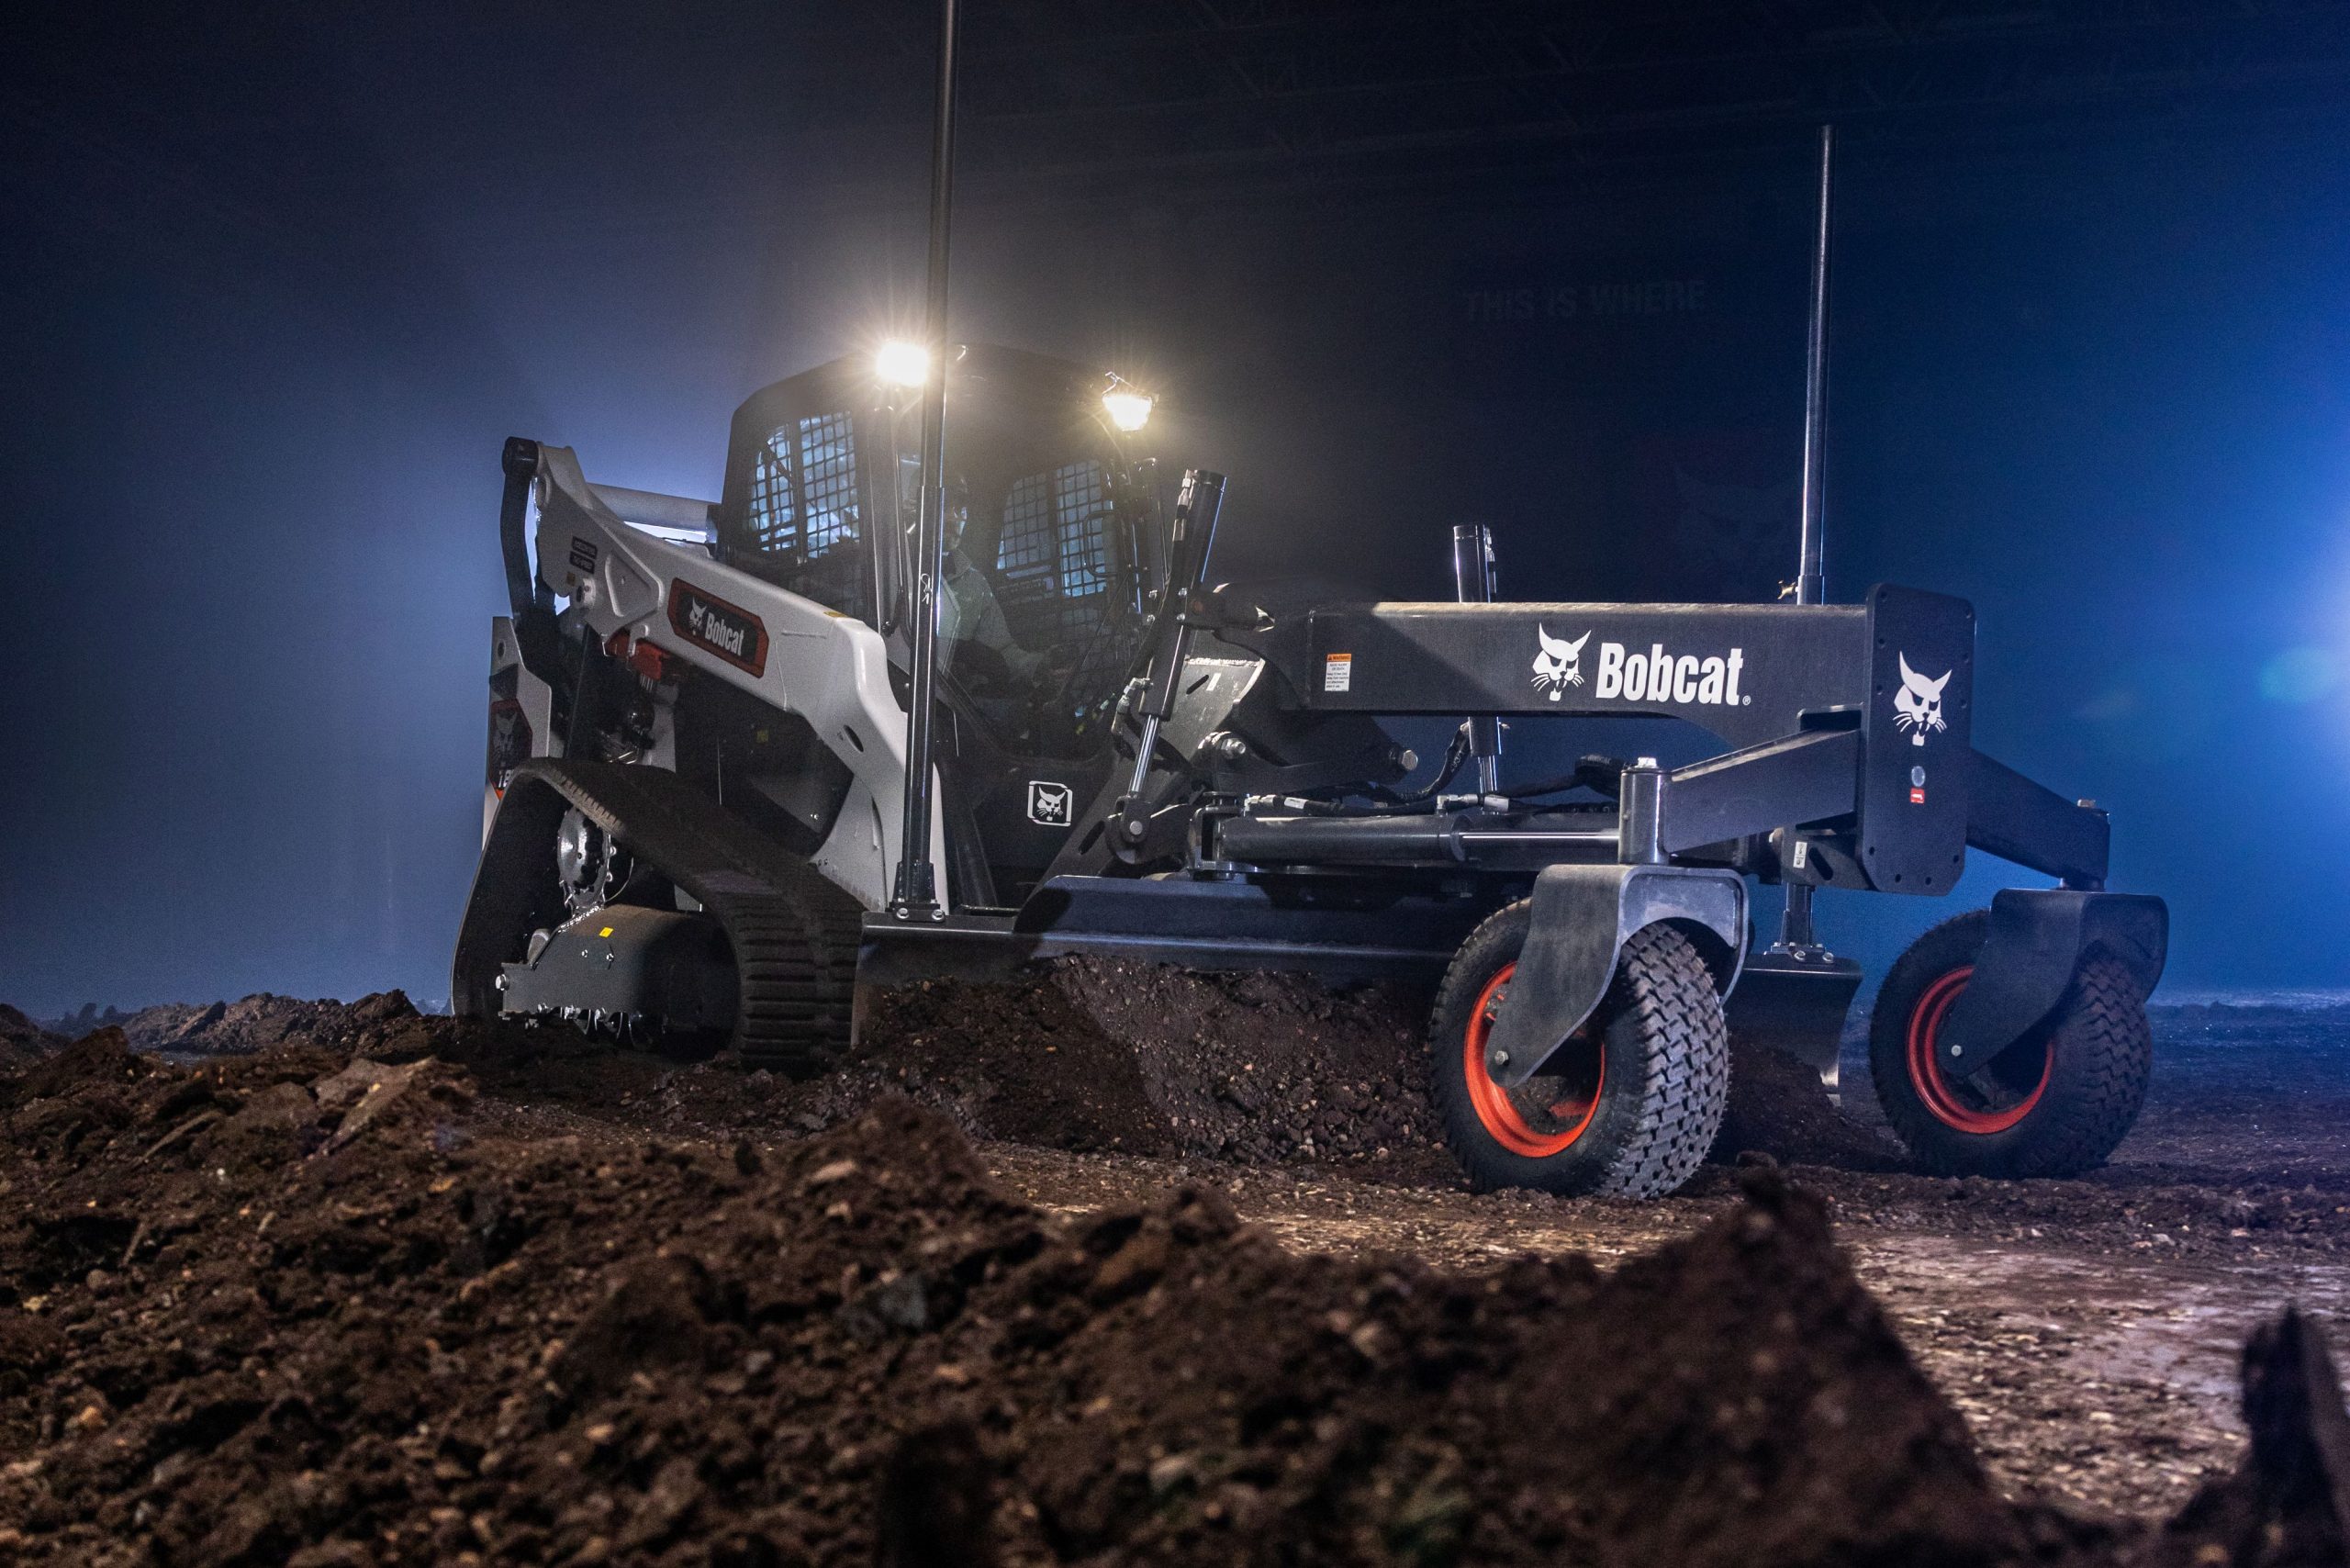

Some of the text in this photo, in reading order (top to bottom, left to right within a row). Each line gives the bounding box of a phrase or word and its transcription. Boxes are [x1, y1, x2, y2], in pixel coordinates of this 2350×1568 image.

[1463, 279, 1706, 321] THIS IS WHERE
[705, 612, 744, 656] Bobcat
[1595, 642, 1744, 706] Bobcat
